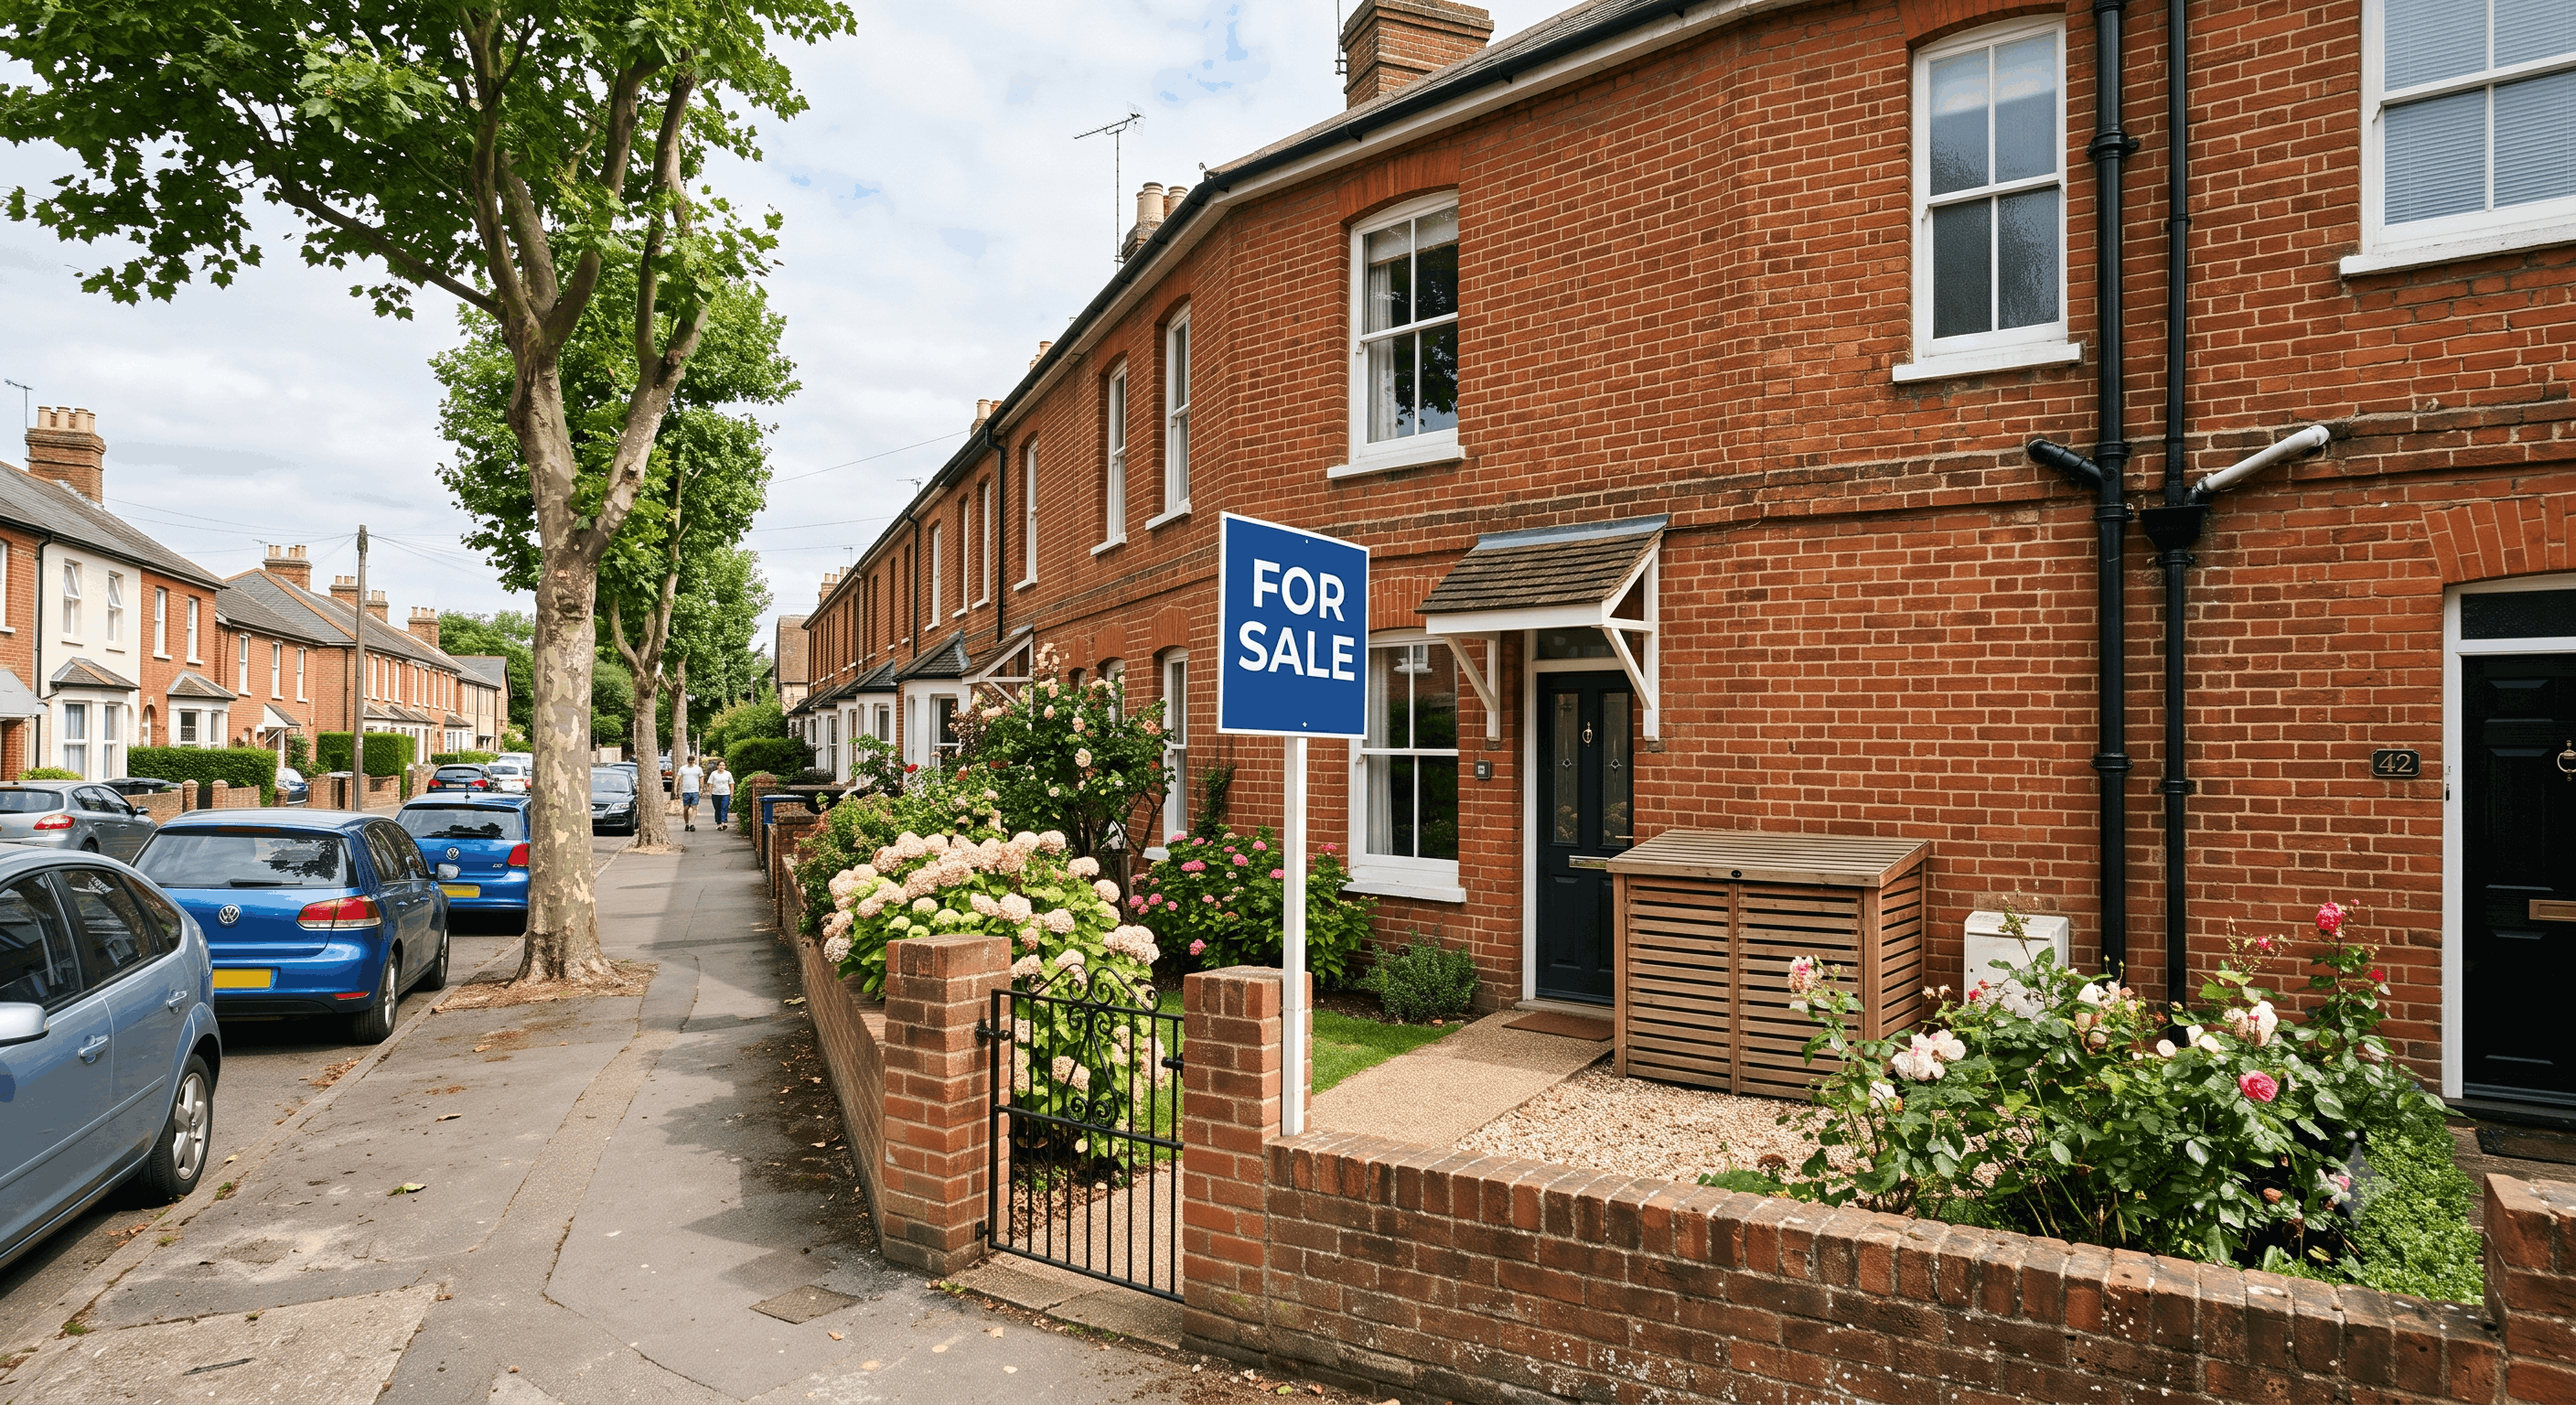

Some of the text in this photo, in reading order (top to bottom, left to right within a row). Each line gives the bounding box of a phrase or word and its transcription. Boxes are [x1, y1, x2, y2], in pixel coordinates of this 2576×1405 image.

[1253, 558, 1346, 622] FOR
[1238, 620, 1356, 681] SALE
[2378, 753, 2413, 773] 42
[219, 905, 240, 925] VW
